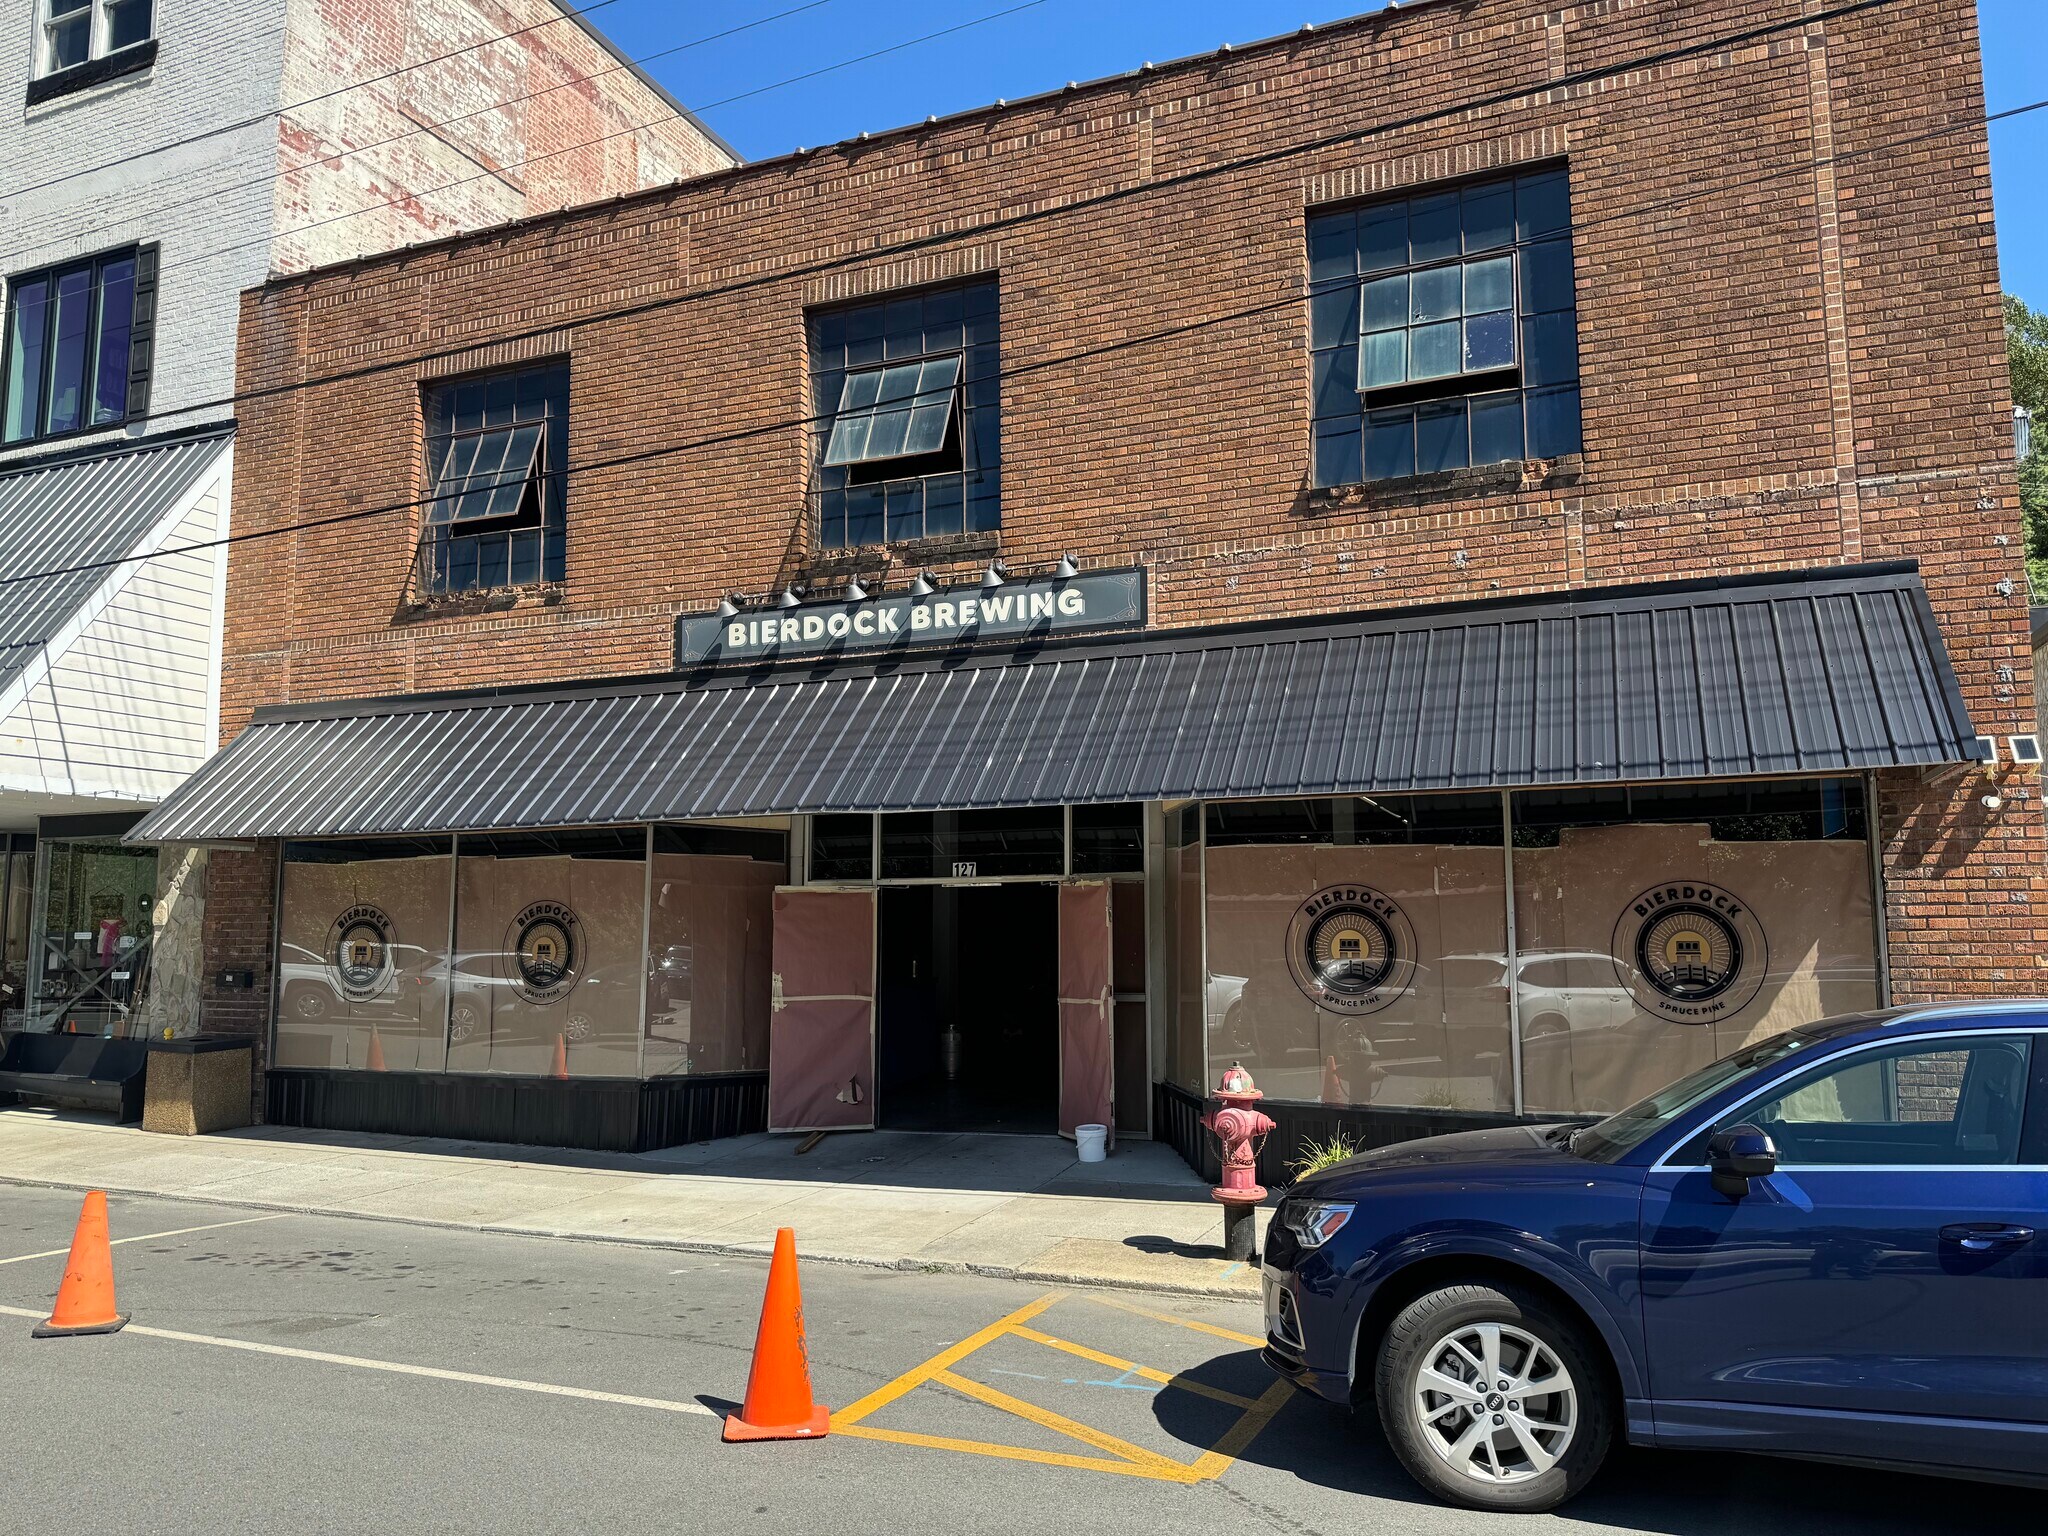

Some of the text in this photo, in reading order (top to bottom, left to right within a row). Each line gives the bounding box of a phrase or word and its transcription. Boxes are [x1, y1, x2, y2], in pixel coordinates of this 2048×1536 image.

[728, 588, 1085, 648] BIERDOCK BREWING
[954, 863, 976, 877] 127
[1304, 889, 1397, 920] BIERDOCK
[1633, 886, 1742, 919] BIERDOCK
[337, 908, 389, 930] BIERDOCK
[517, 904, 575, 928] BIERDOCK
[343, 987, 362, 996] SPRUCE
[524, 988, 560, 998] SPRUCE PINE
[1323, 994, 1380, 1007] SPRUCE PINE
[1658, 1001, 1726, 1015] SPRUCE PINE
